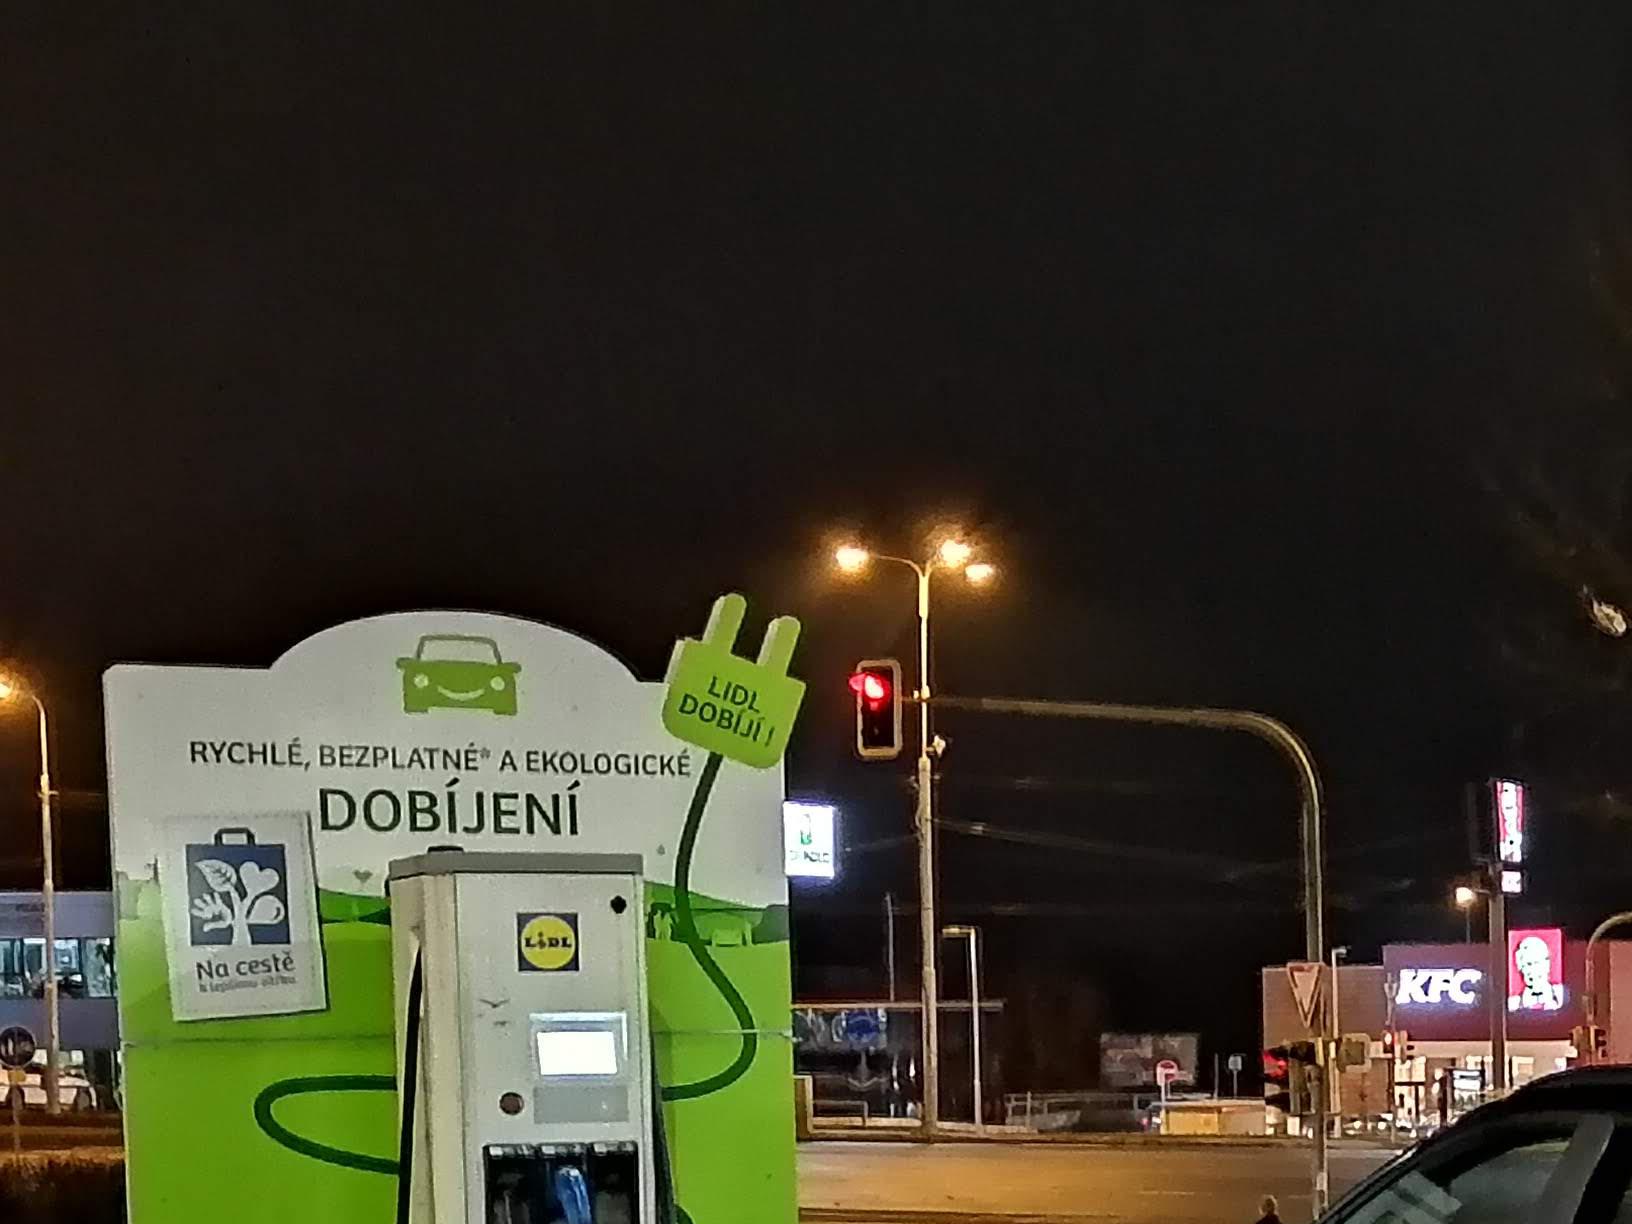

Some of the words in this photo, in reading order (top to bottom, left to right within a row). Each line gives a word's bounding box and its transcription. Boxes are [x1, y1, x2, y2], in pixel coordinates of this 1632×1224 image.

[707, 674, 760, 713] LIDL
[678, 693, 765, 742] DOBÍJÍ
[190, 737, 311, 772] RYCHLÉ,
[499, 750, 518, 772] A
[526, 748, 691, 777] EKOLOGICKÉ
[319, 777, 580, 836] DOBÍJENÍ
[196, 960, 230, 980] Na
[236, 949, 296, 976] cestě
[1395, 968, 1482, 1004] KFC
